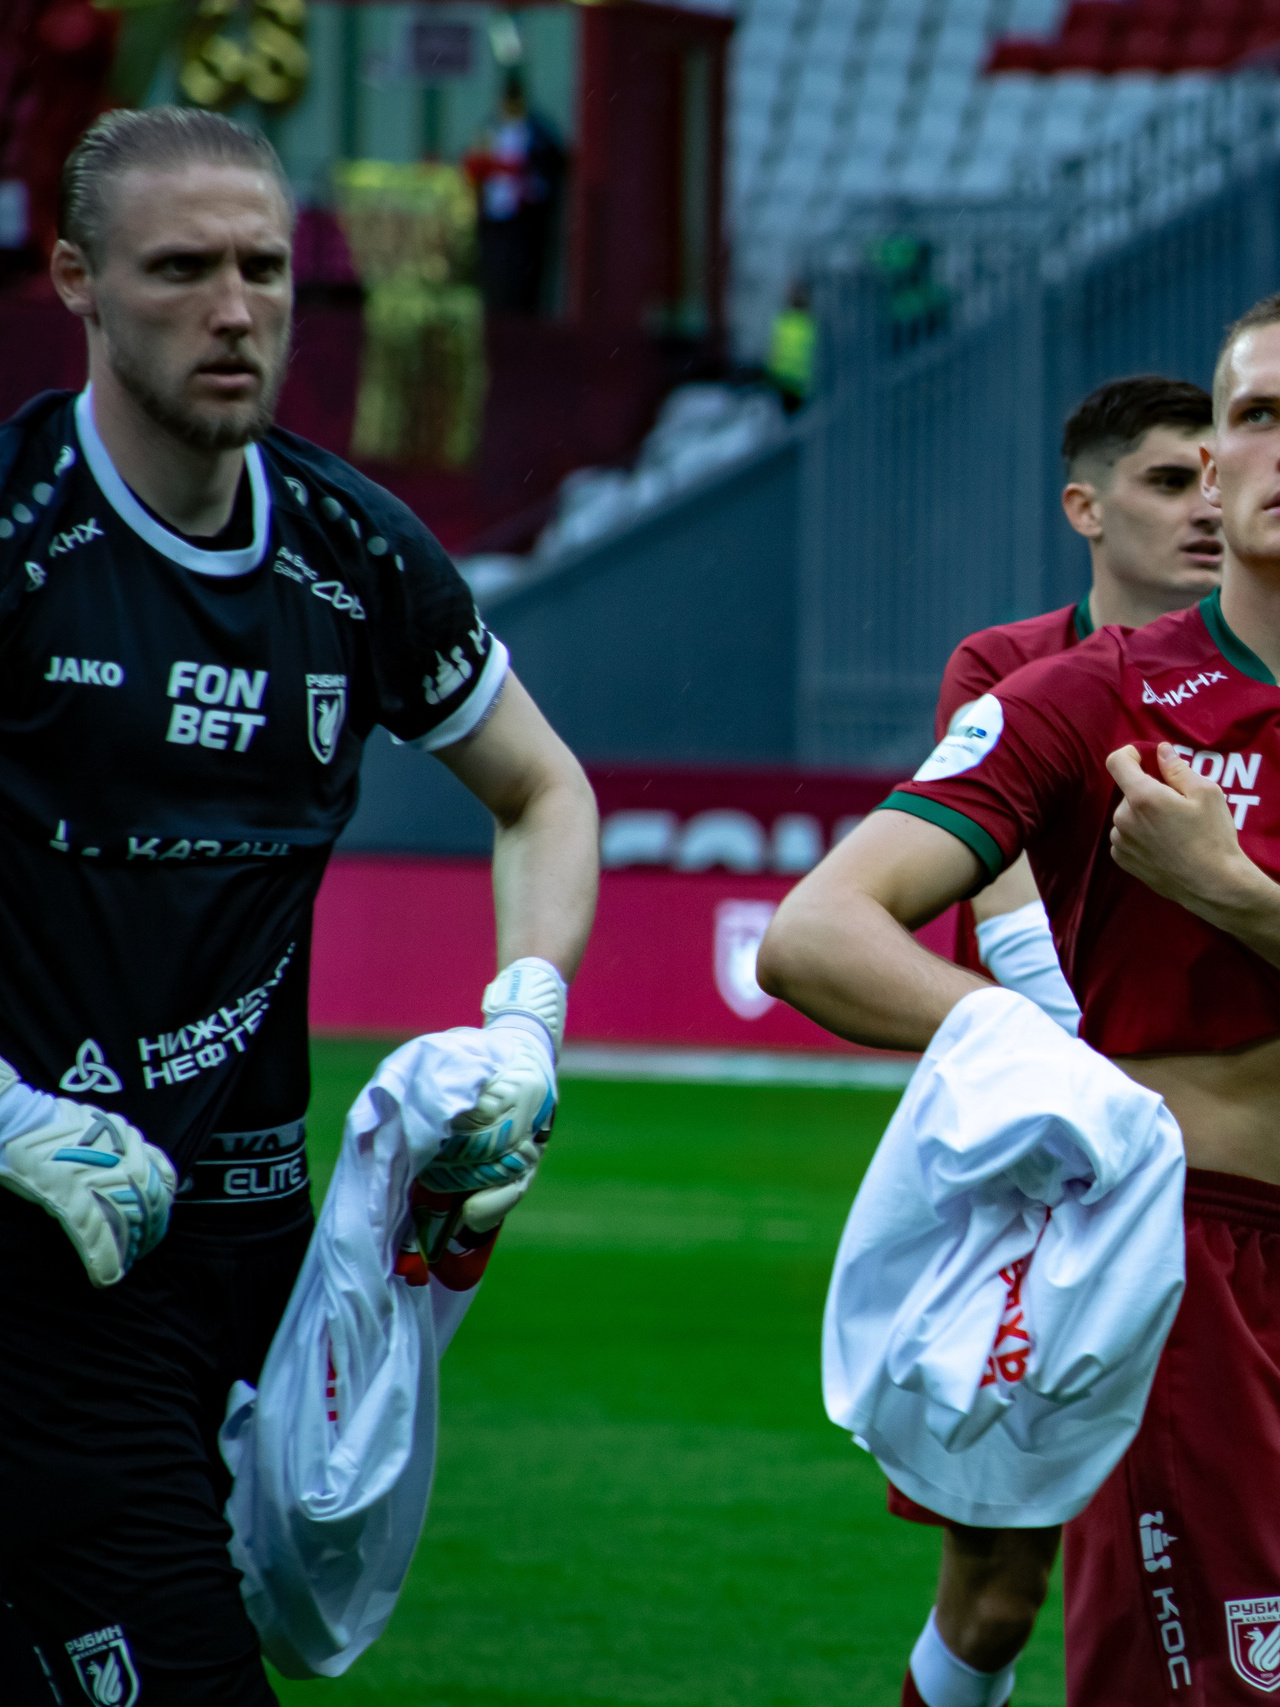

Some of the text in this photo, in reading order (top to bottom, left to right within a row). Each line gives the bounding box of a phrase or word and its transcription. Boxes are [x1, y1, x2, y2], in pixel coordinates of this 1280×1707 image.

[44, 656, 124, 688] JAKO
[166, 660, 268, 709] FON
[165, 703, 266, 753] BET
[223, 1157, 301, 1195] ELITE
[64, 1624, 123, 1655] РУБИН
